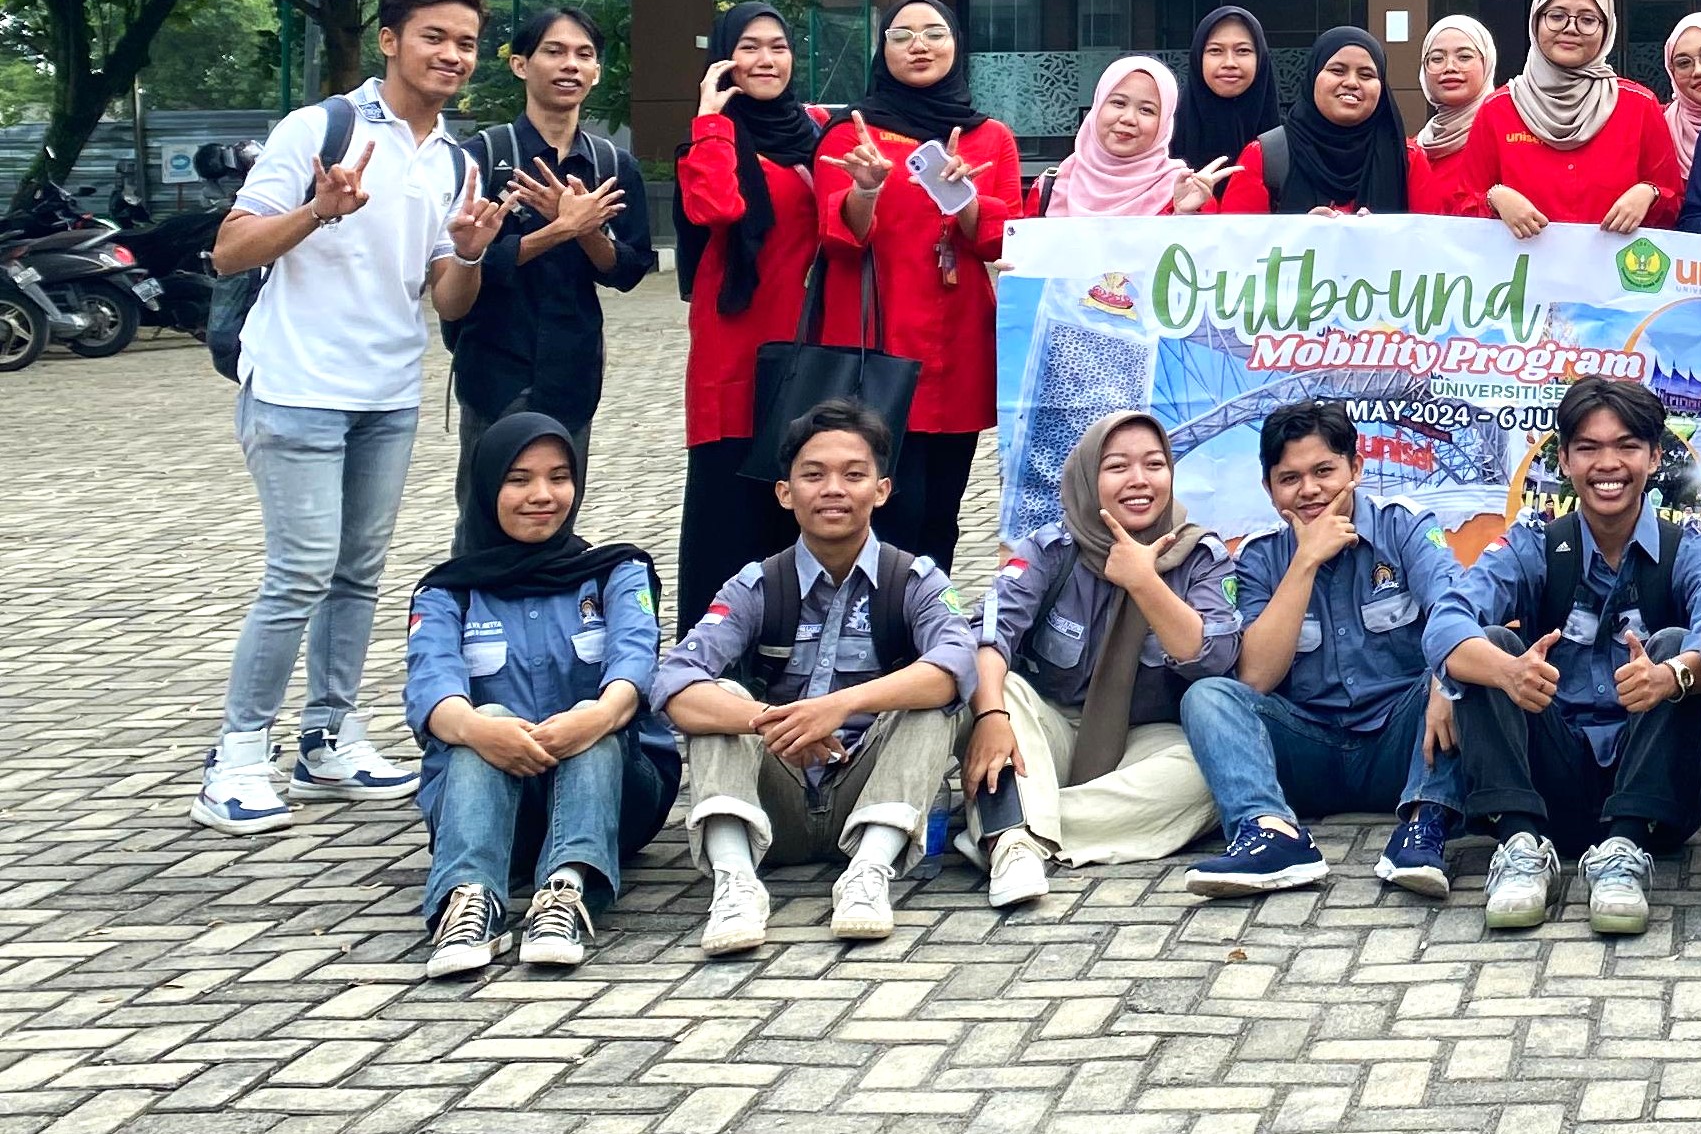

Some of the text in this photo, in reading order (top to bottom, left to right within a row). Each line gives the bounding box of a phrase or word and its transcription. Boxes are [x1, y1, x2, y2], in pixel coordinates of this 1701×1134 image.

[1151, 242, 1541, 344] Outbound
[1249, 330, 1645, 382] Mobility Program
[1432, 381, 1537, 400] UNIVERSITI
[1345, 400, 1407, 422] MAY
[1410, 402, 1471, 426] 2024
[1499, 407, 1515, 430] 6
[1520, 408, 1560, 431] JU
